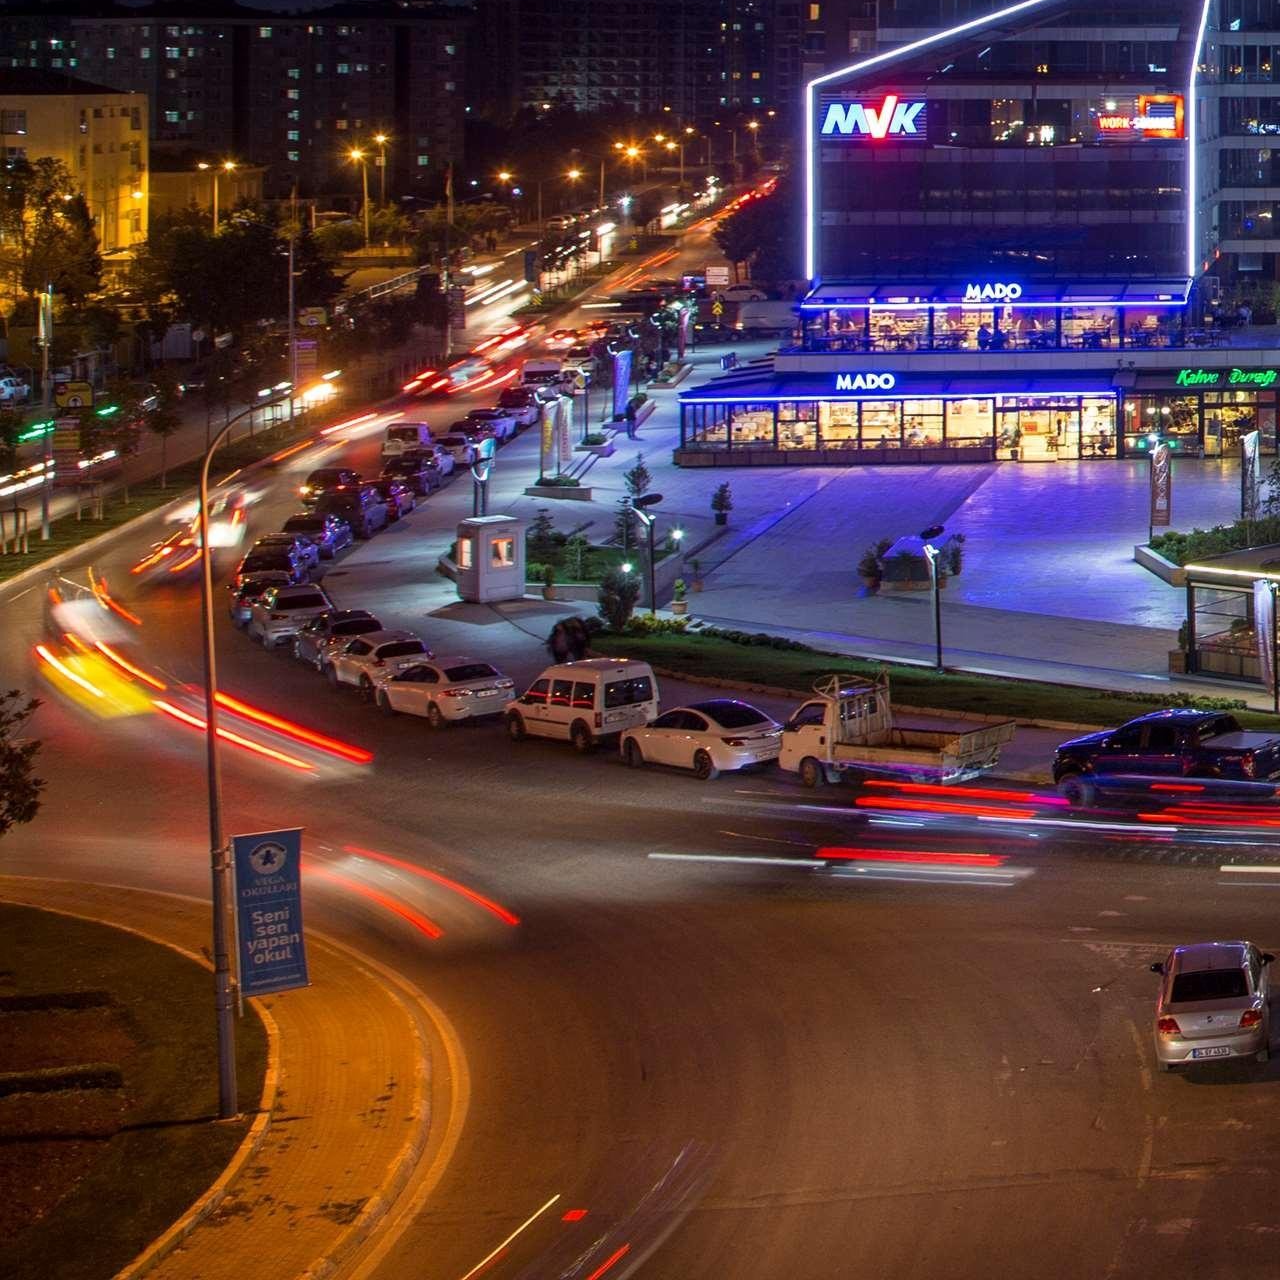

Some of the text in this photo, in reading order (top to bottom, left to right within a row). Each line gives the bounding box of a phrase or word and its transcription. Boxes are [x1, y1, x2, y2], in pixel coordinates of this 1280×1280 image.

[821, 96, 925, 138] MVK
[965, 283, 1022, 299] MADO
[836, 374, 895, 390] MADO
[1176, 369, 1219, 386] Kahve
[252, 907, 290, 924] Seni
[256, 922, 288, 937] sen
[247, 932, 300, 954] yapan
[254, 948, 293, 964] okul
